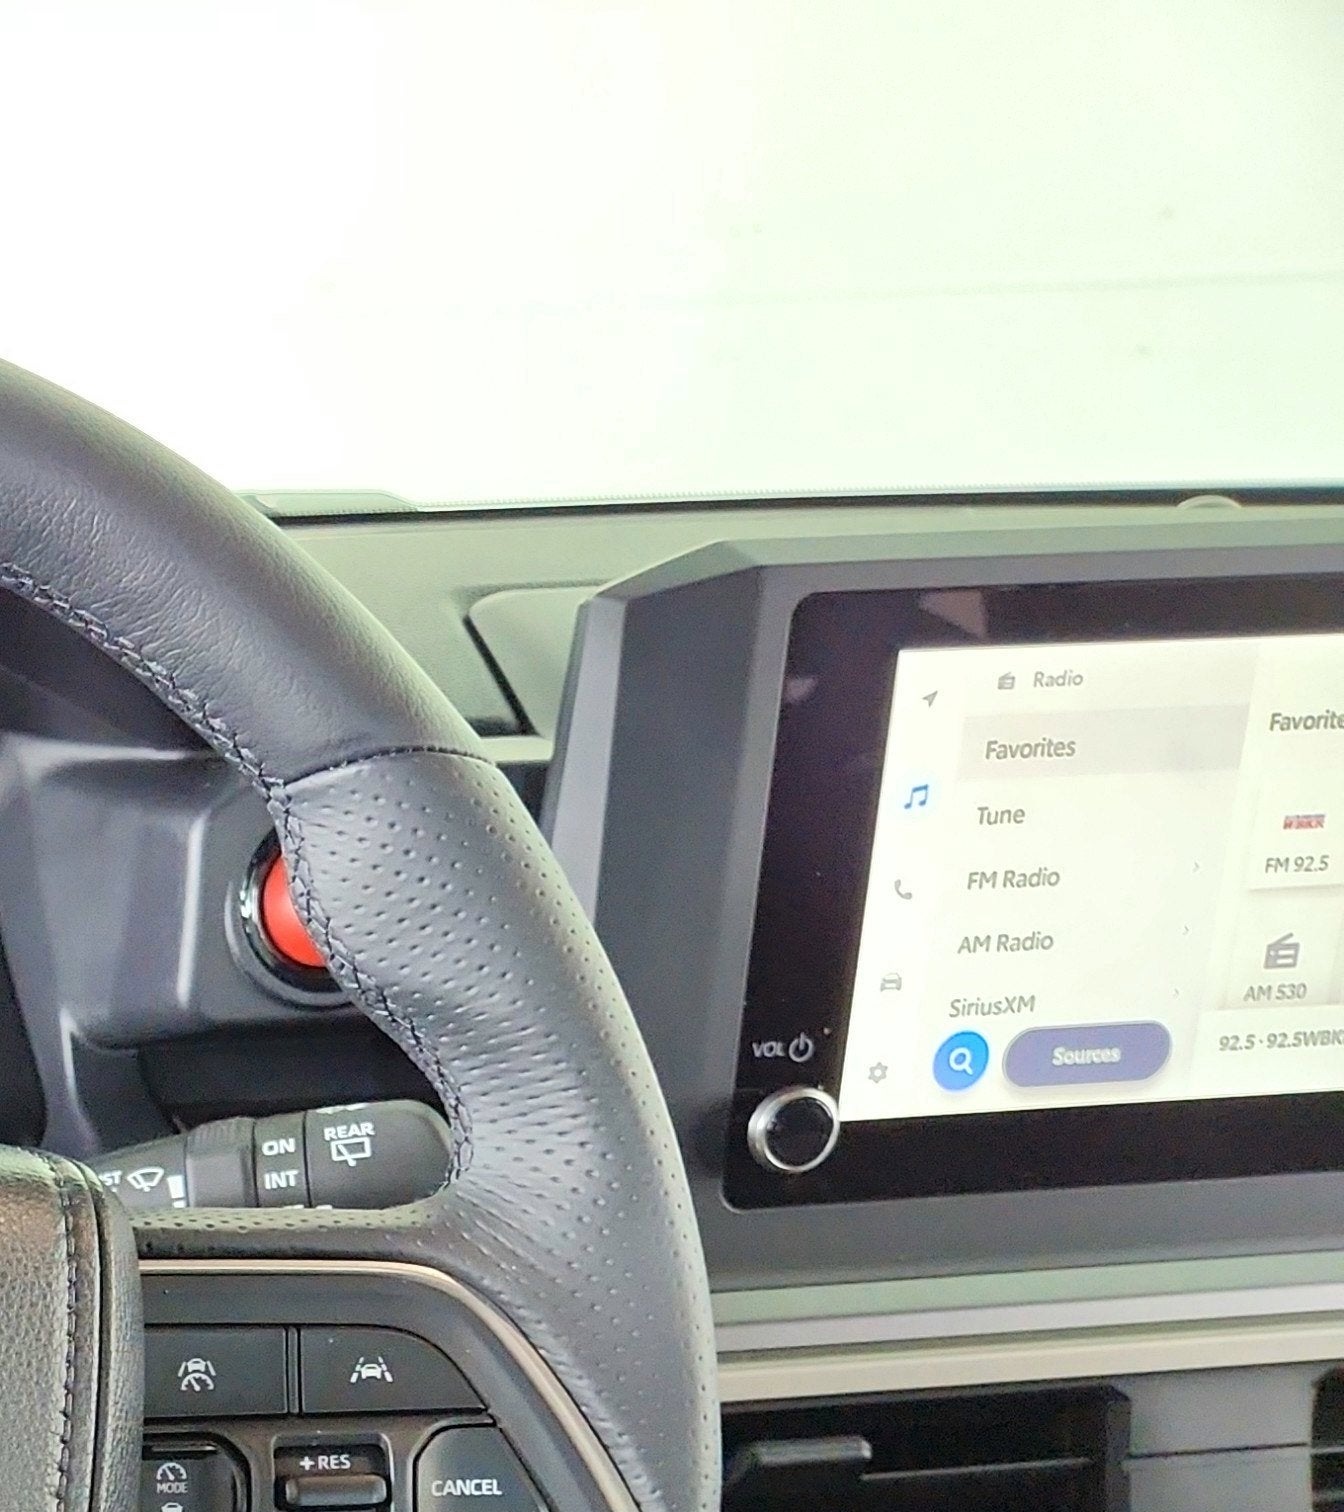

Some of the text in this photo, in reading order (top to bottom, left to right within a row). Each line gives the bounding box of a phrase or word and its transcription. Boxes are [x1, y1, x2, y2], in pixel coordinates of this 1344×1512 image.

[1032, 669, 1084, 688] Radio
[985, 737, 1076, 760] Favorites
[977, 805, 1025, 826] Tune
[1265, 854, 1329, 873] FM 92.5
[967, 868, 1060, 890] FM Radio
[957, 932, 1054, 954] AM Radio
[1243, 982, 1307, 1001] AM 530
[948, 995, 1036, 1018] SiriusXM
[752, 1041, 785, 1058] VOL
[1219, 1033, 1255, 1051] 92.5
[1052, 1045, 1121, 1067] Sources
[323, 1121, 376, 1139] REAR
[262, 1138, 296, 1156] ON
[264, 1170, 299, 1190] INT
[156, 1481, 188, 1494] MODE
[431, 1479, 503, 1497] CANCEL
